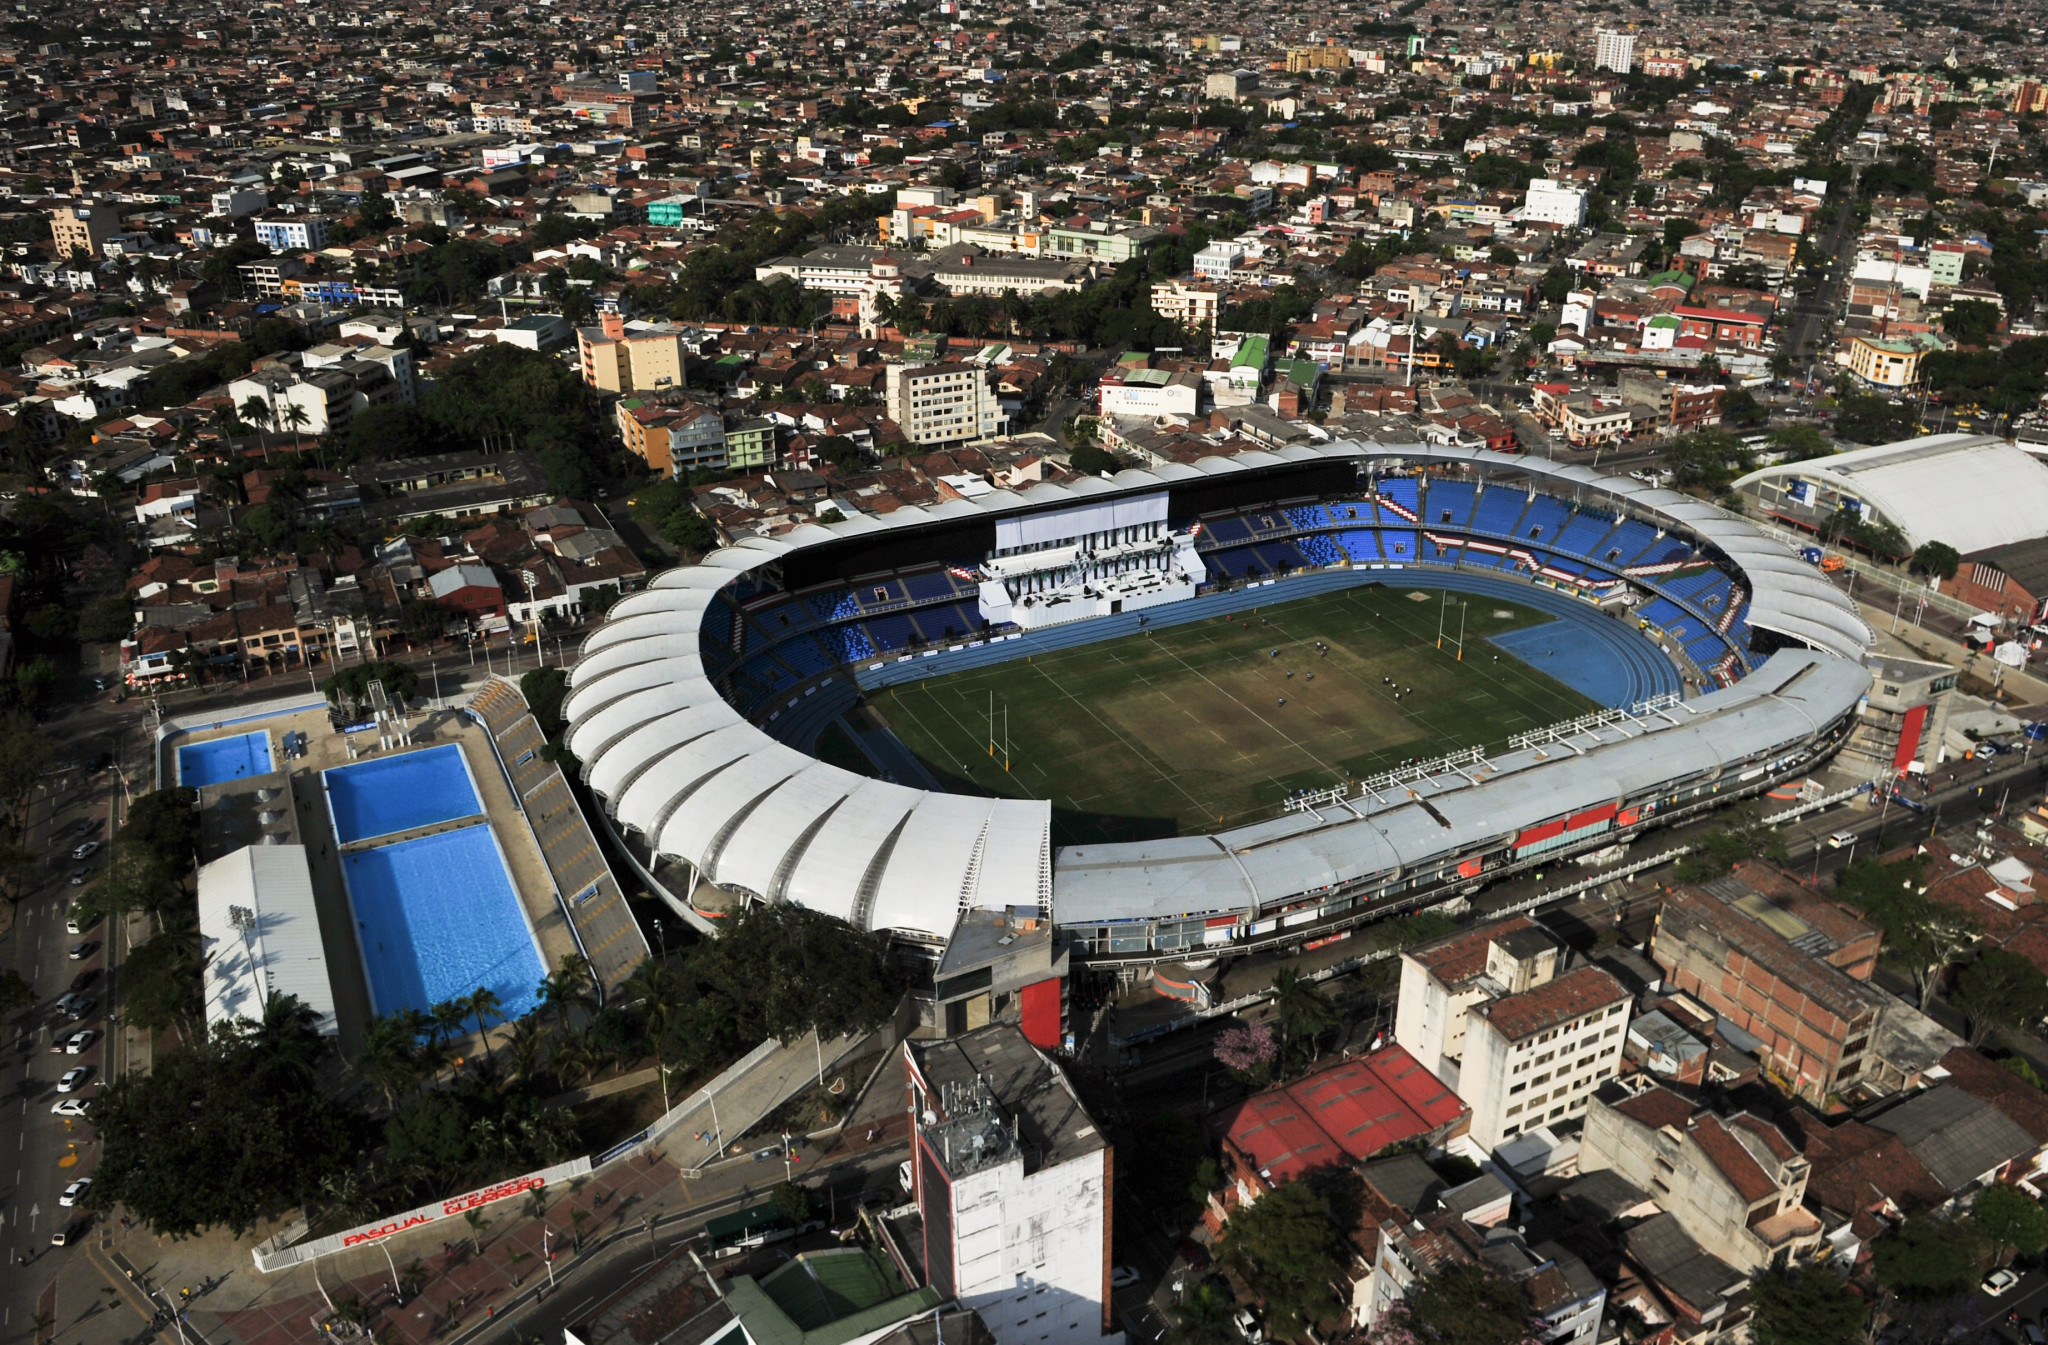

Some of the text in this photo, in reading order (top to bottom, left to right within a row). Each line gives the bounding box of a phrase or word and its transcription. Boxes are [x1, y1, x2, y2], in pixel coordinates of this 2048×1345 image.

[443, 1192, 479, 1206] ESTADIO
[444, 1177, 545, 1216] GUERRERO
[343, 1215, 434, 1247] PASCUAL
